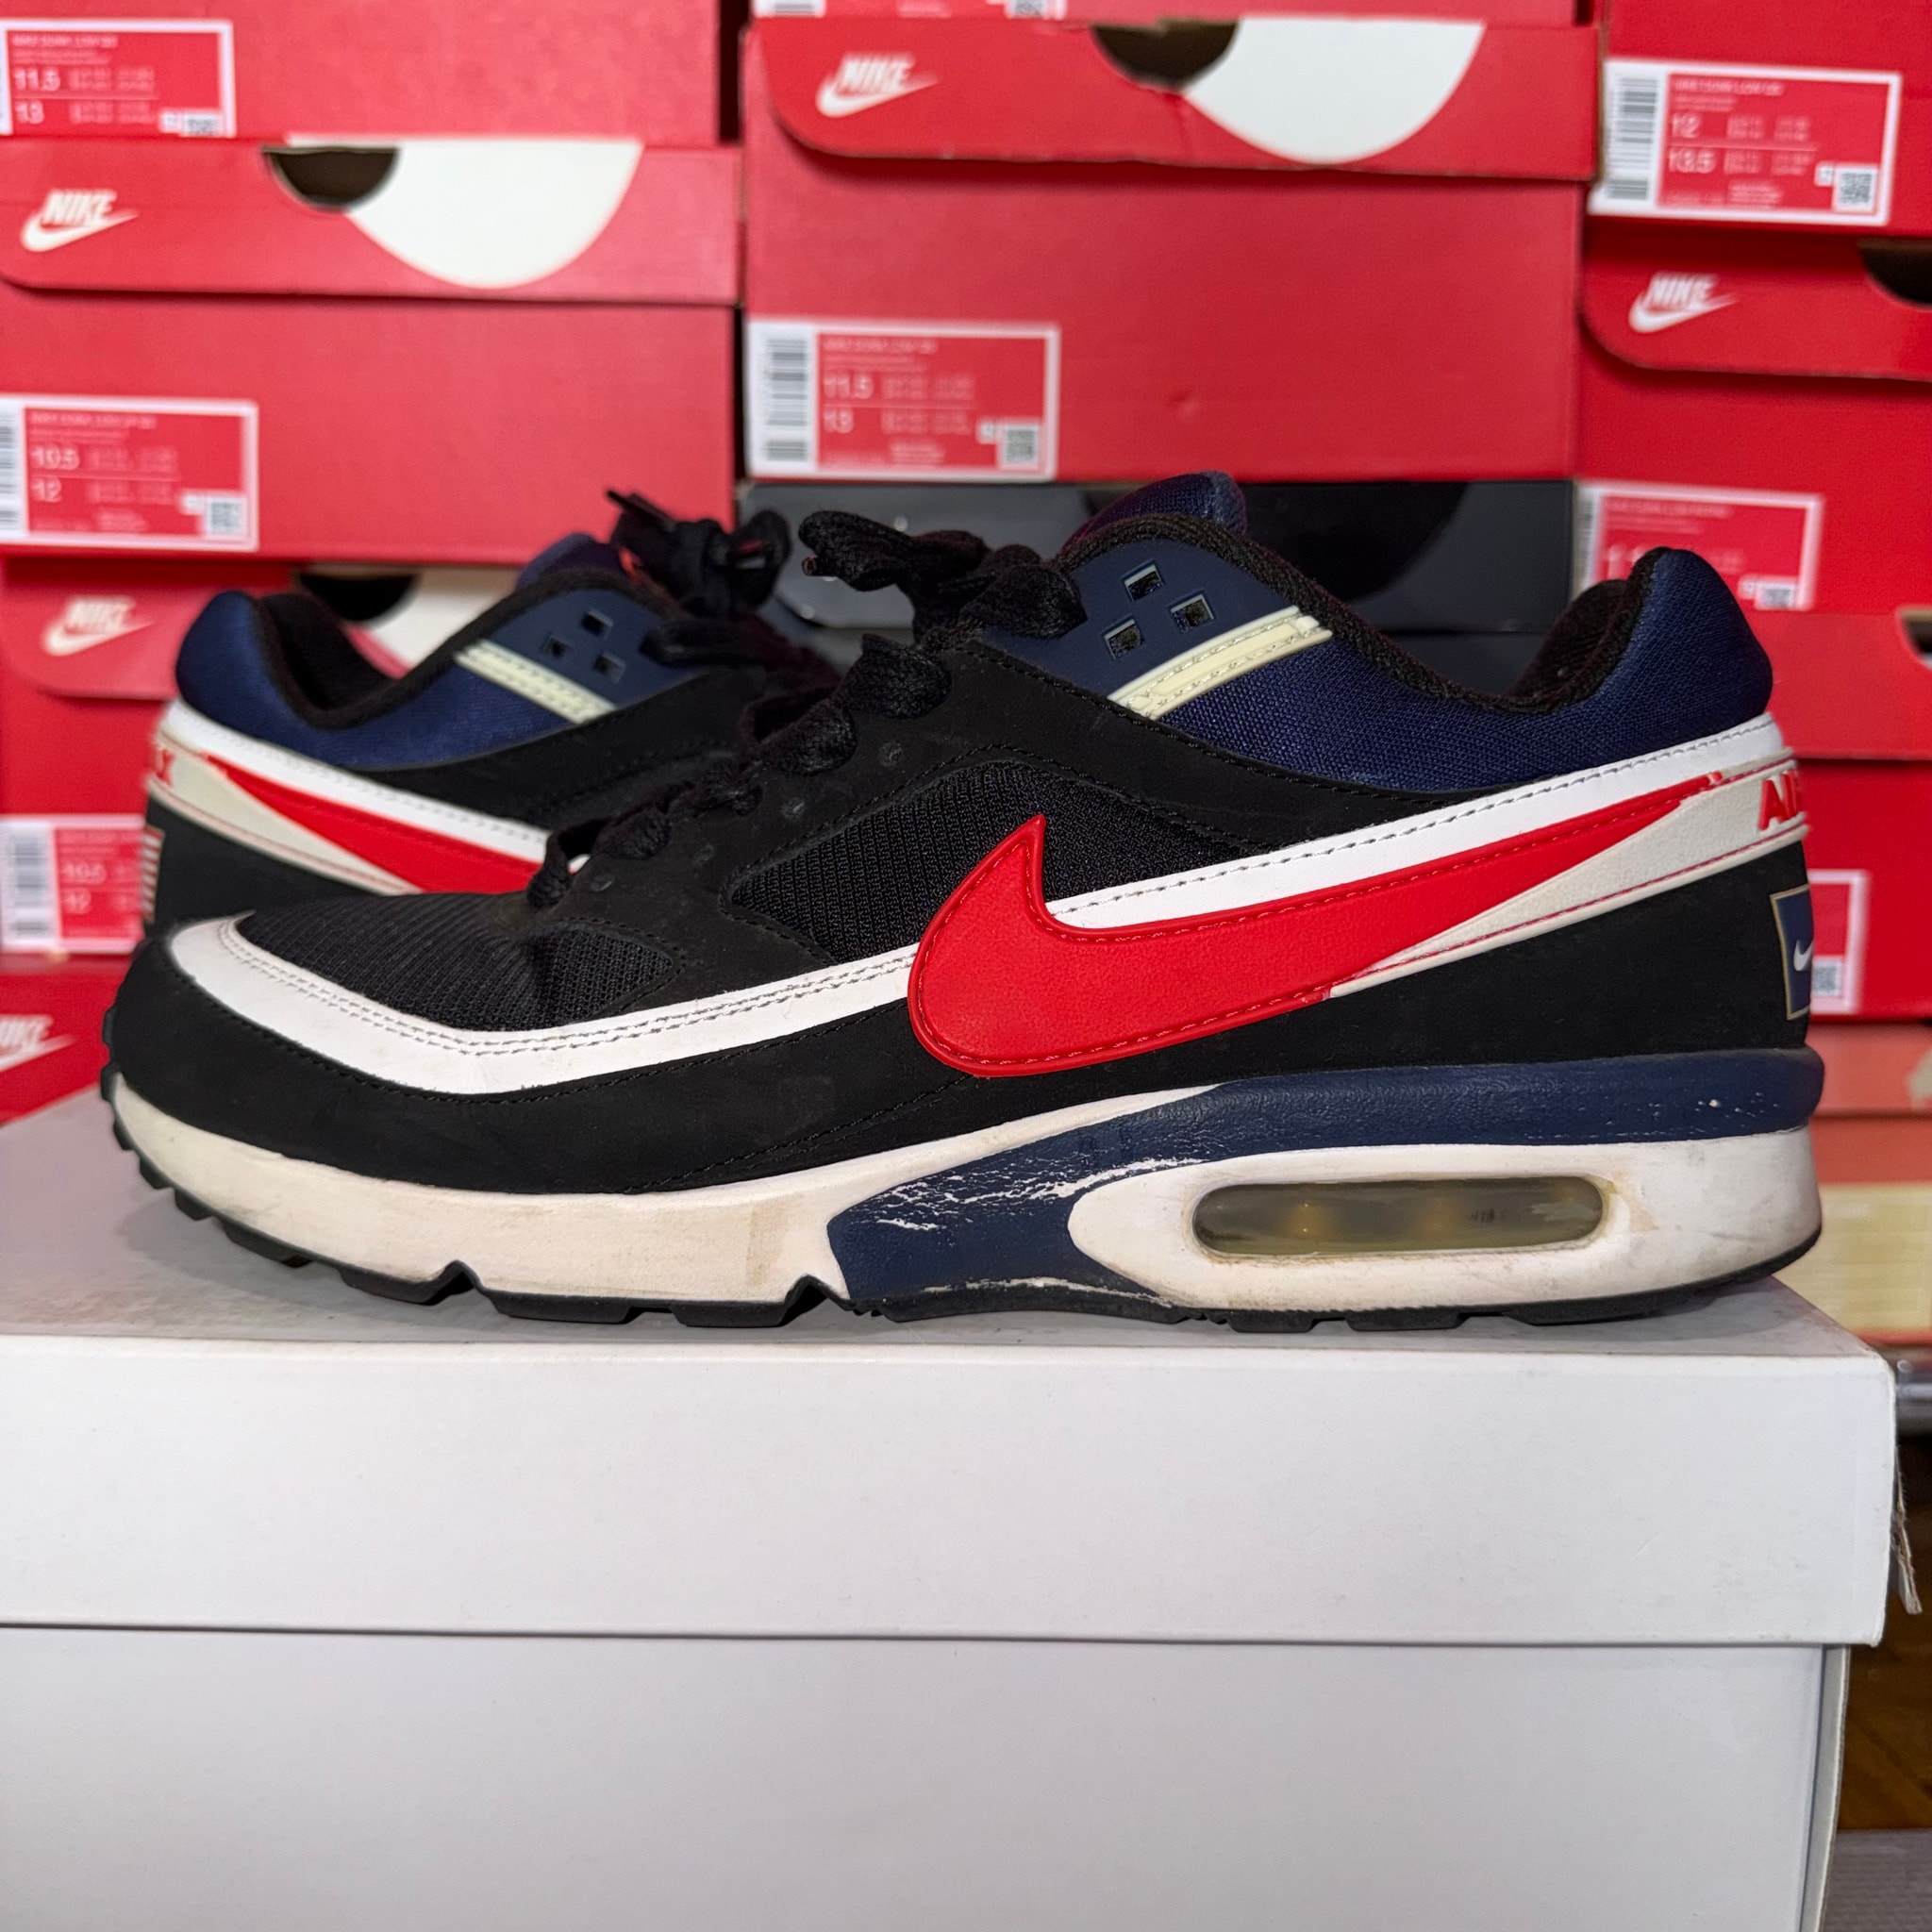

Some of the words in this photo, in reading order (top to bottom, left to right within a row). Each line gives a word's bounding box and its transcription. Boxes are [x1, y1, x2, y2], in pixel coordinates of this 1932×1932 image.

[836, 53, 916, 94] NIKE
[14, 100, 45, 125] 13
[1670, 112, 1703, 140] 12
[41, 189, 118, 226] NIKE
[1646, 272, 1720, 311] NIKE
[30, 476, 62, 502] 12
[63, 595, 137, 635] NIKE
